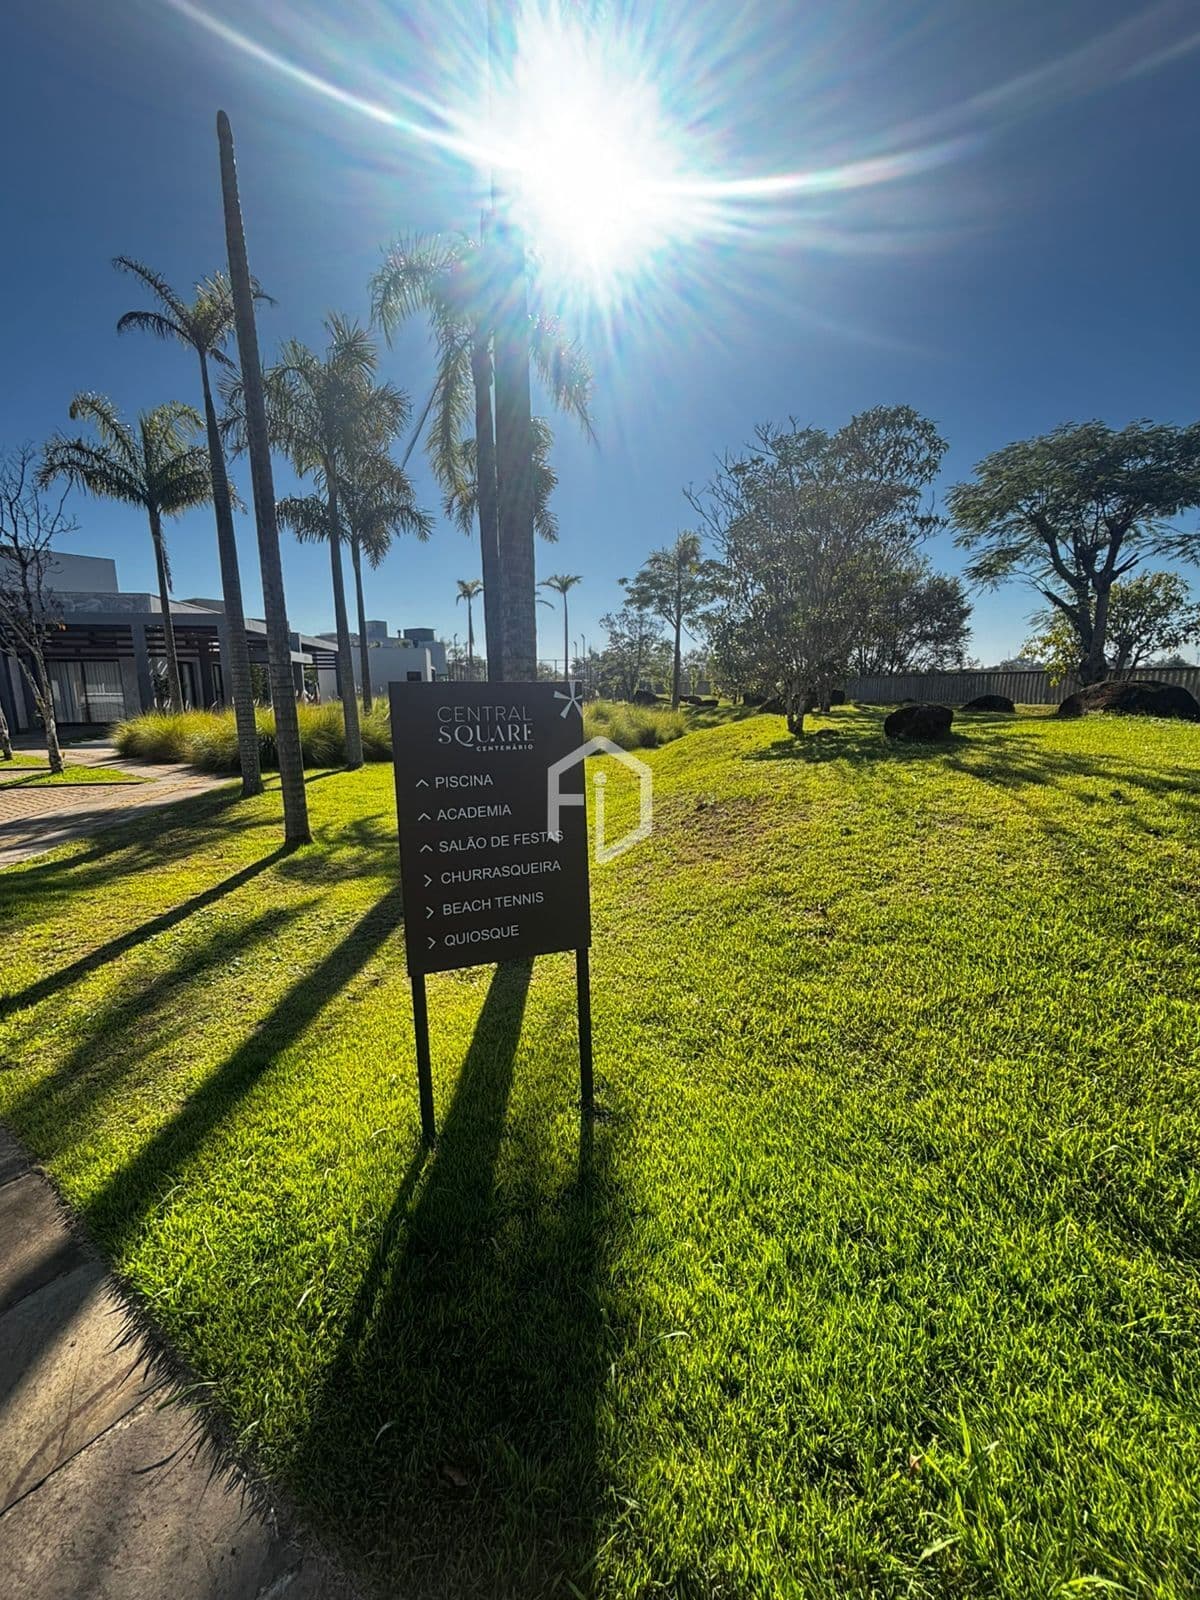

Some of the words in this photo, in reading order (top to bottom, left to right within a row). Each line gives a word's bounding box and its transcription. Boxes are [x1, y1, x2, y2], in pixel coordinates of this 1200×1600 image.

[437, 705, 532, 723] CENTRAL
[438, 723, 535, 747] SQUARE
[476, 744, 534, 752] CENTENÁRIO
[434, 774, 494, 789] PISCINA
[436, 804, 512, 822] ACADEMIA
[438, 836, 488, 854] SALÃO
[491, 834, 511, 848] DE
[513, 830, 565, 846] FESTAS
[440, 860, 562, 885] CHURRASQUEIRA
[442, 897, 492, 916] BEACH
[495, 891, 545, 909] TENNIS
[444, 925, 520, 947] QUIOSQUE
